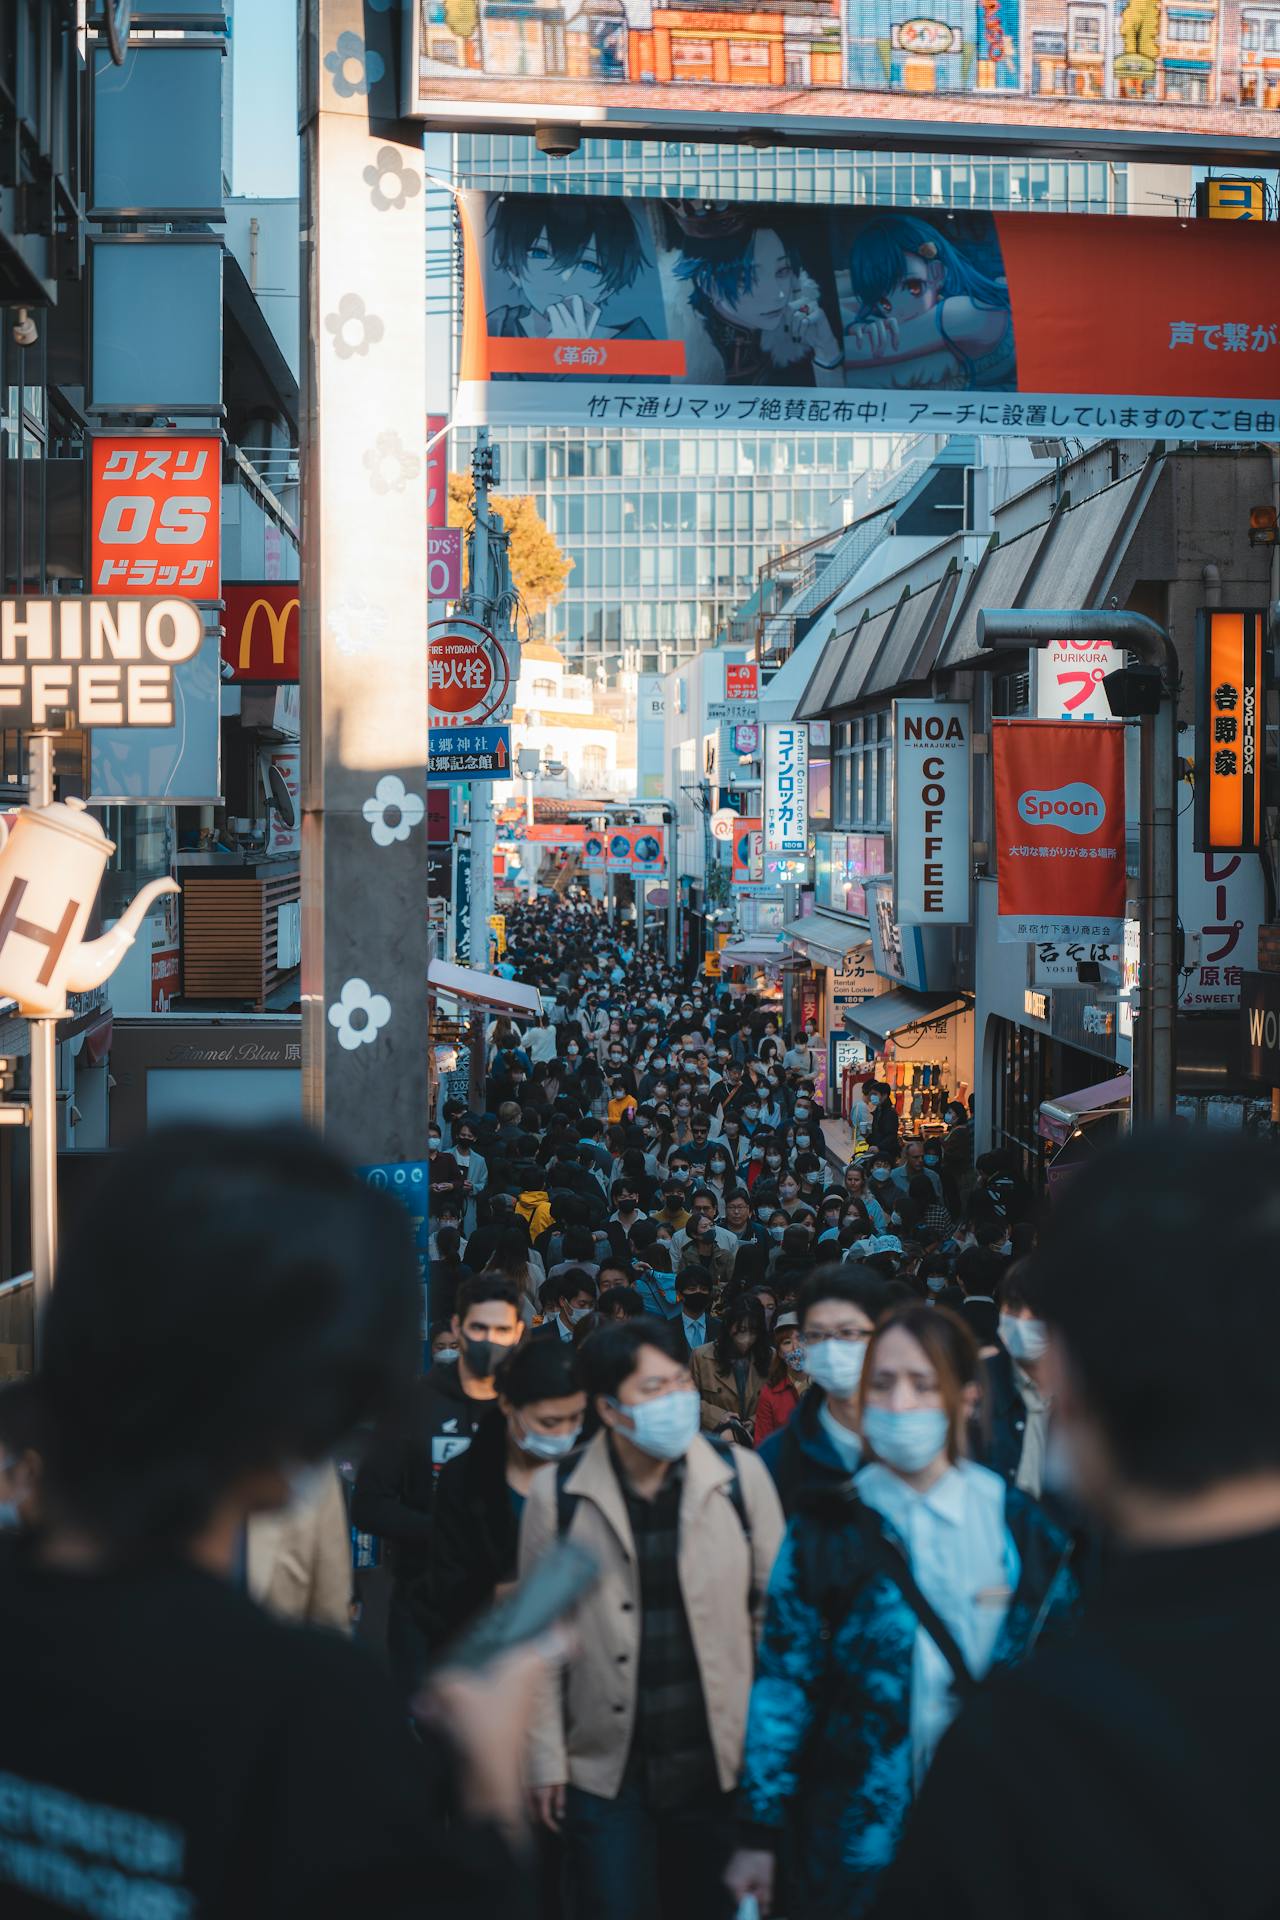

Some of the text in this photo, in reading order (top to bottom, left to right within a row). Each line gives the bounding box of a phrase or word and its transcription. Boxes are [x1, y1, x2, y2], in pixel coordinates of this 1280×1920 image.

[1168, 321, 1280, 353] 声で繋が
[907, 401, 1280, 434] アーチに設置していますのでご自由
[102, 450, 208, 481] クスリ
[98, 496, 212, 545] OS
[97, 559, 214, 586] ドラッグ
[445, 644, 478, 655] HYDRANT
[1053, 653, 1108, 663] PURIKURA
[903, 716, 965, 741] NOA
[1214, 682, 1240, 777] 吉野家
[778, 730, 794, 836] コインロッカー
[1024, 798, 1099, 820] Spoon
[921, 756, 946, 913] COFFEE
[1008, 845, 1118, 860] 大切な繋がりがある場所
[1016, 923, 1112, 937] 原宿竹下通り商店会
[1199, 966, 1242, 986] 原宿
[1195, 994, 1235, 1003] SWEET
[1249, 1007, 1280, 1048] WO
[234, 1042, 281, 1061] Blau
